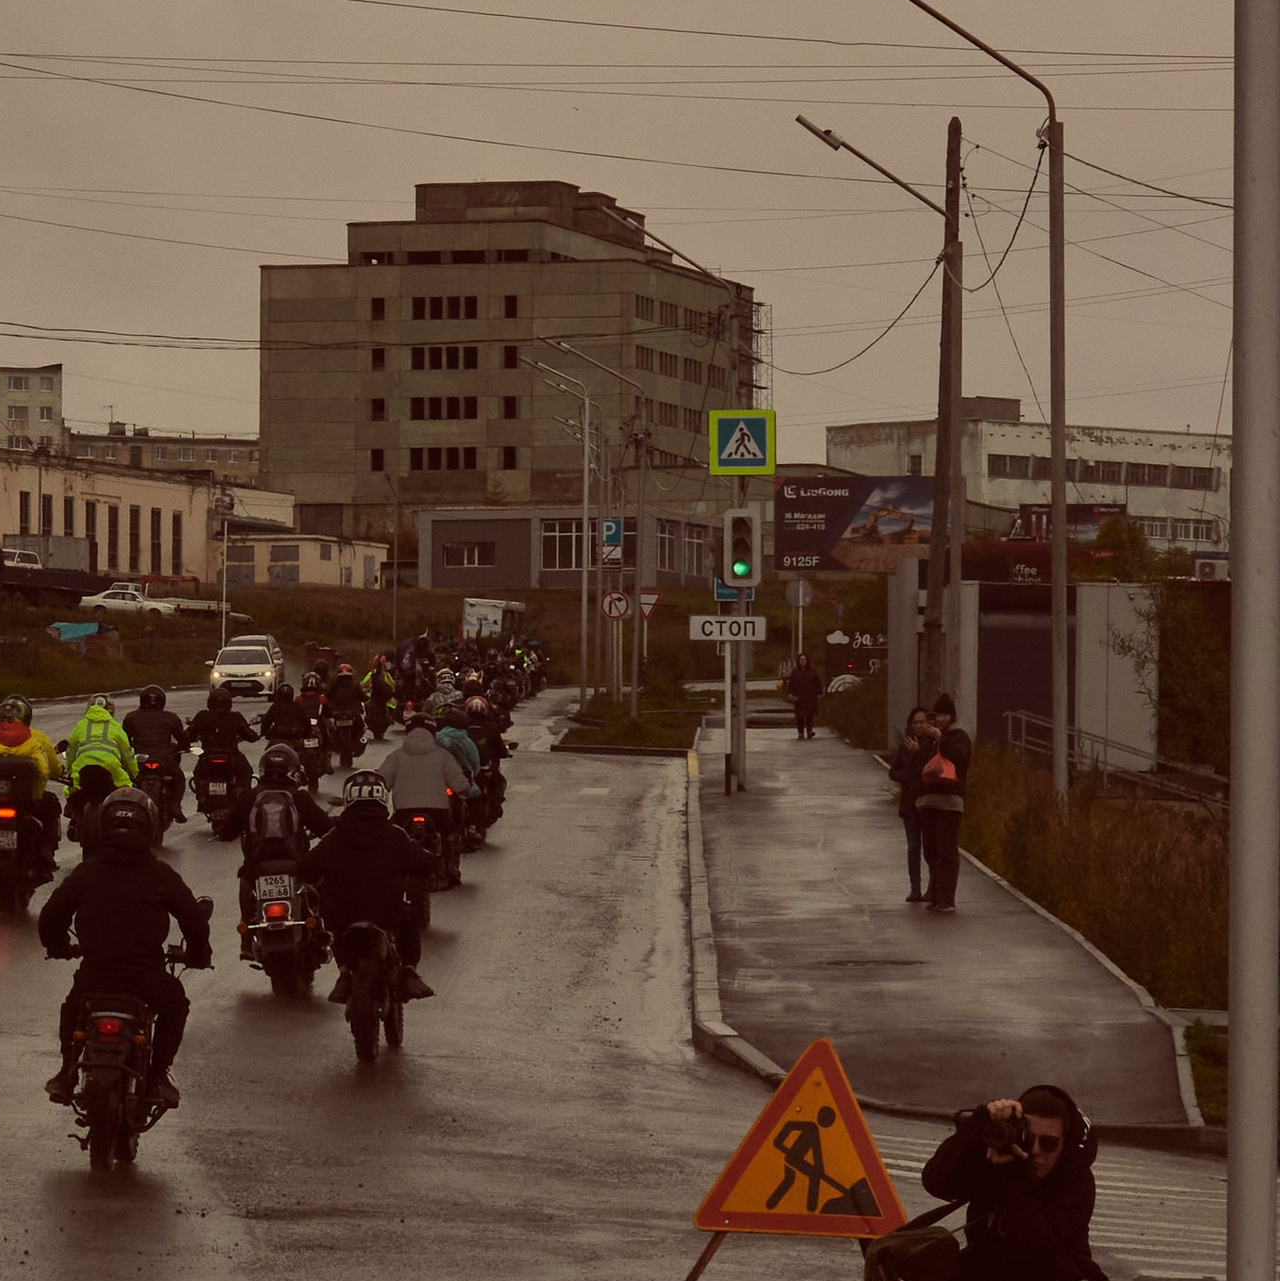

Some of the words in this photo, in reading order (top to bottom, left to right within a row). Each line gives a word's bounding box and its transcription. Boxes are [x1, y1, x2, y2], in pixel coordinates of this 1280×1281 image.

[783, 556, 820, 567] 9125F
[701, 620, 755, 637] СТОП
[263, 876, 285, 886] 1265
[277, 888, 289, 897] 68
